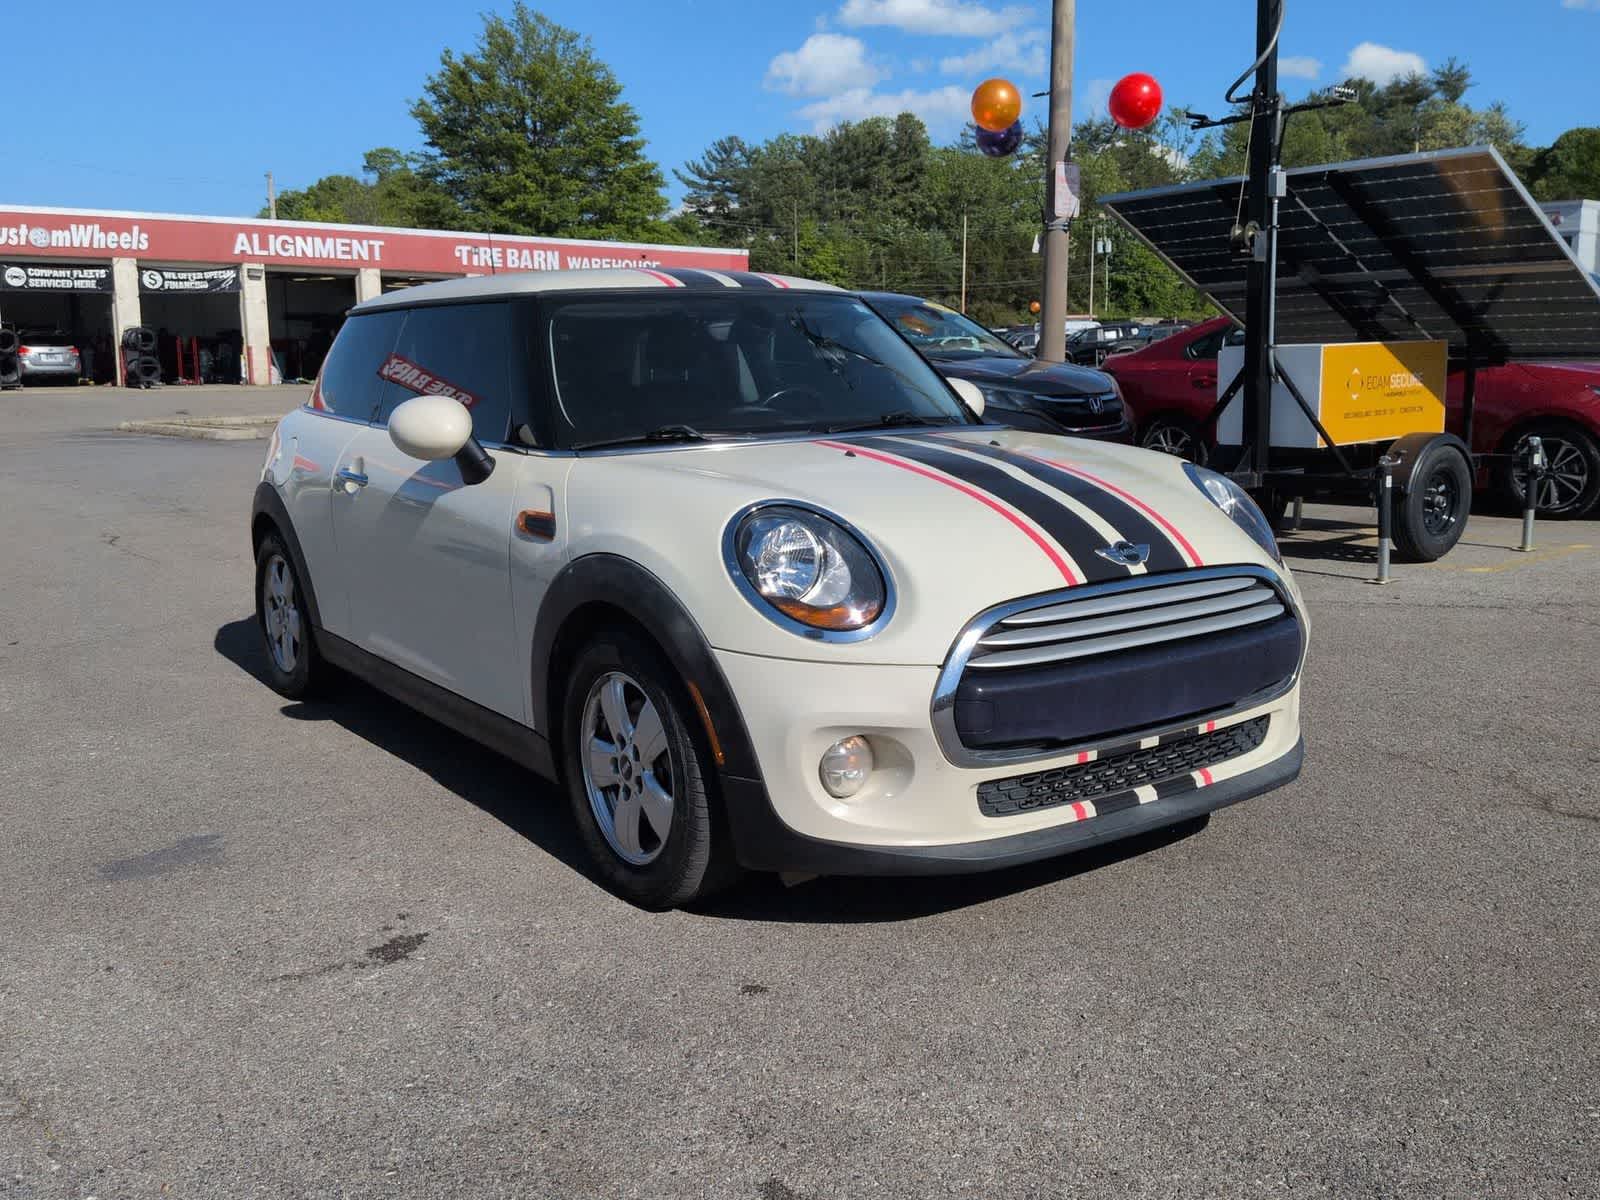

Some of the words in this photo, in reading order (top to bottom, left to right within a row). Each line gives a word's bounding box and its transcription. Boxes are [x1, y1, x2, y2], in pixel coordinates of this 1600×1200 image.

[233, 233, 384, 261] ALIGNMENT
[506, 248, 560, 270] BARN
[28, 279, 73, 288] SERVICED
